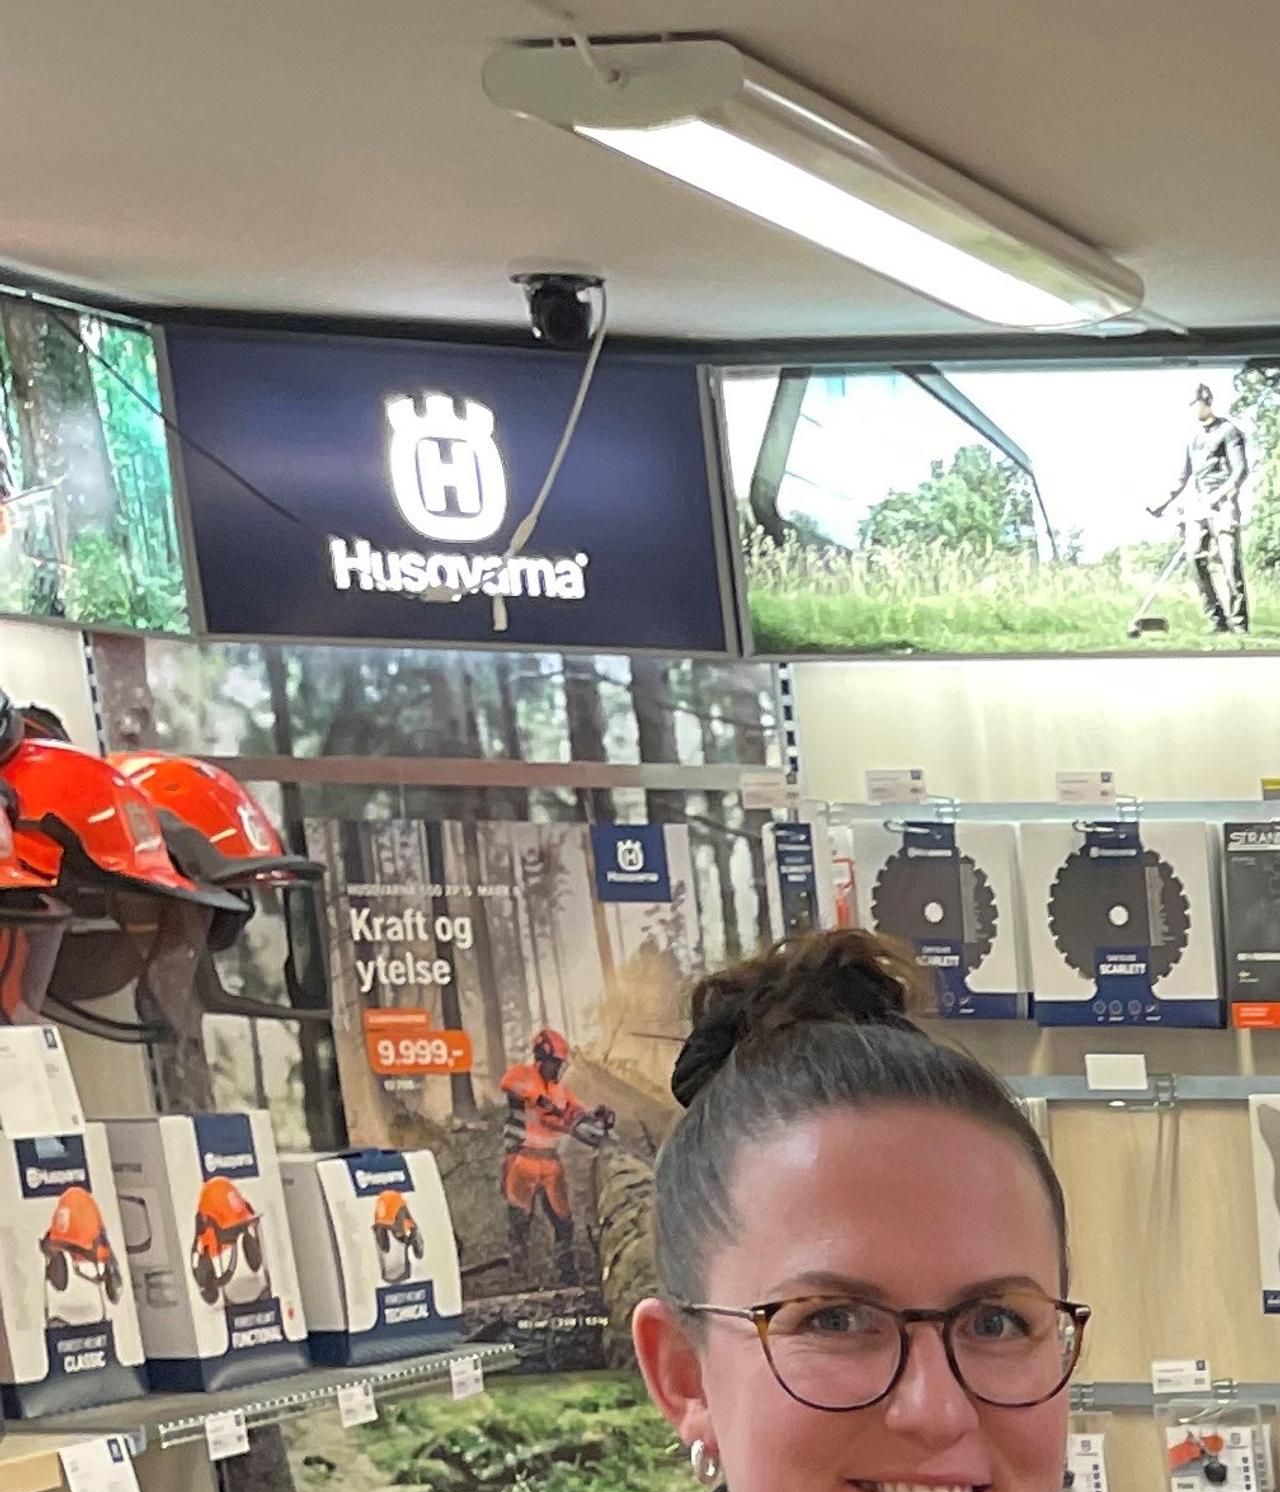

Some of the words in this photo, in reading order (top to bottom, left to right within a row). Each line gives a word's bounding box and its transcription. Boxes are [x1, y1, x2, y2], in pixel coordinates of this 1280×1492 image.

[350, 906, 429, 942] Kraft
[435, 915, 473, 949] og
[356, 952, 452, 992] ytelse
[377, 1039, 464, 1068] 9.999,-
